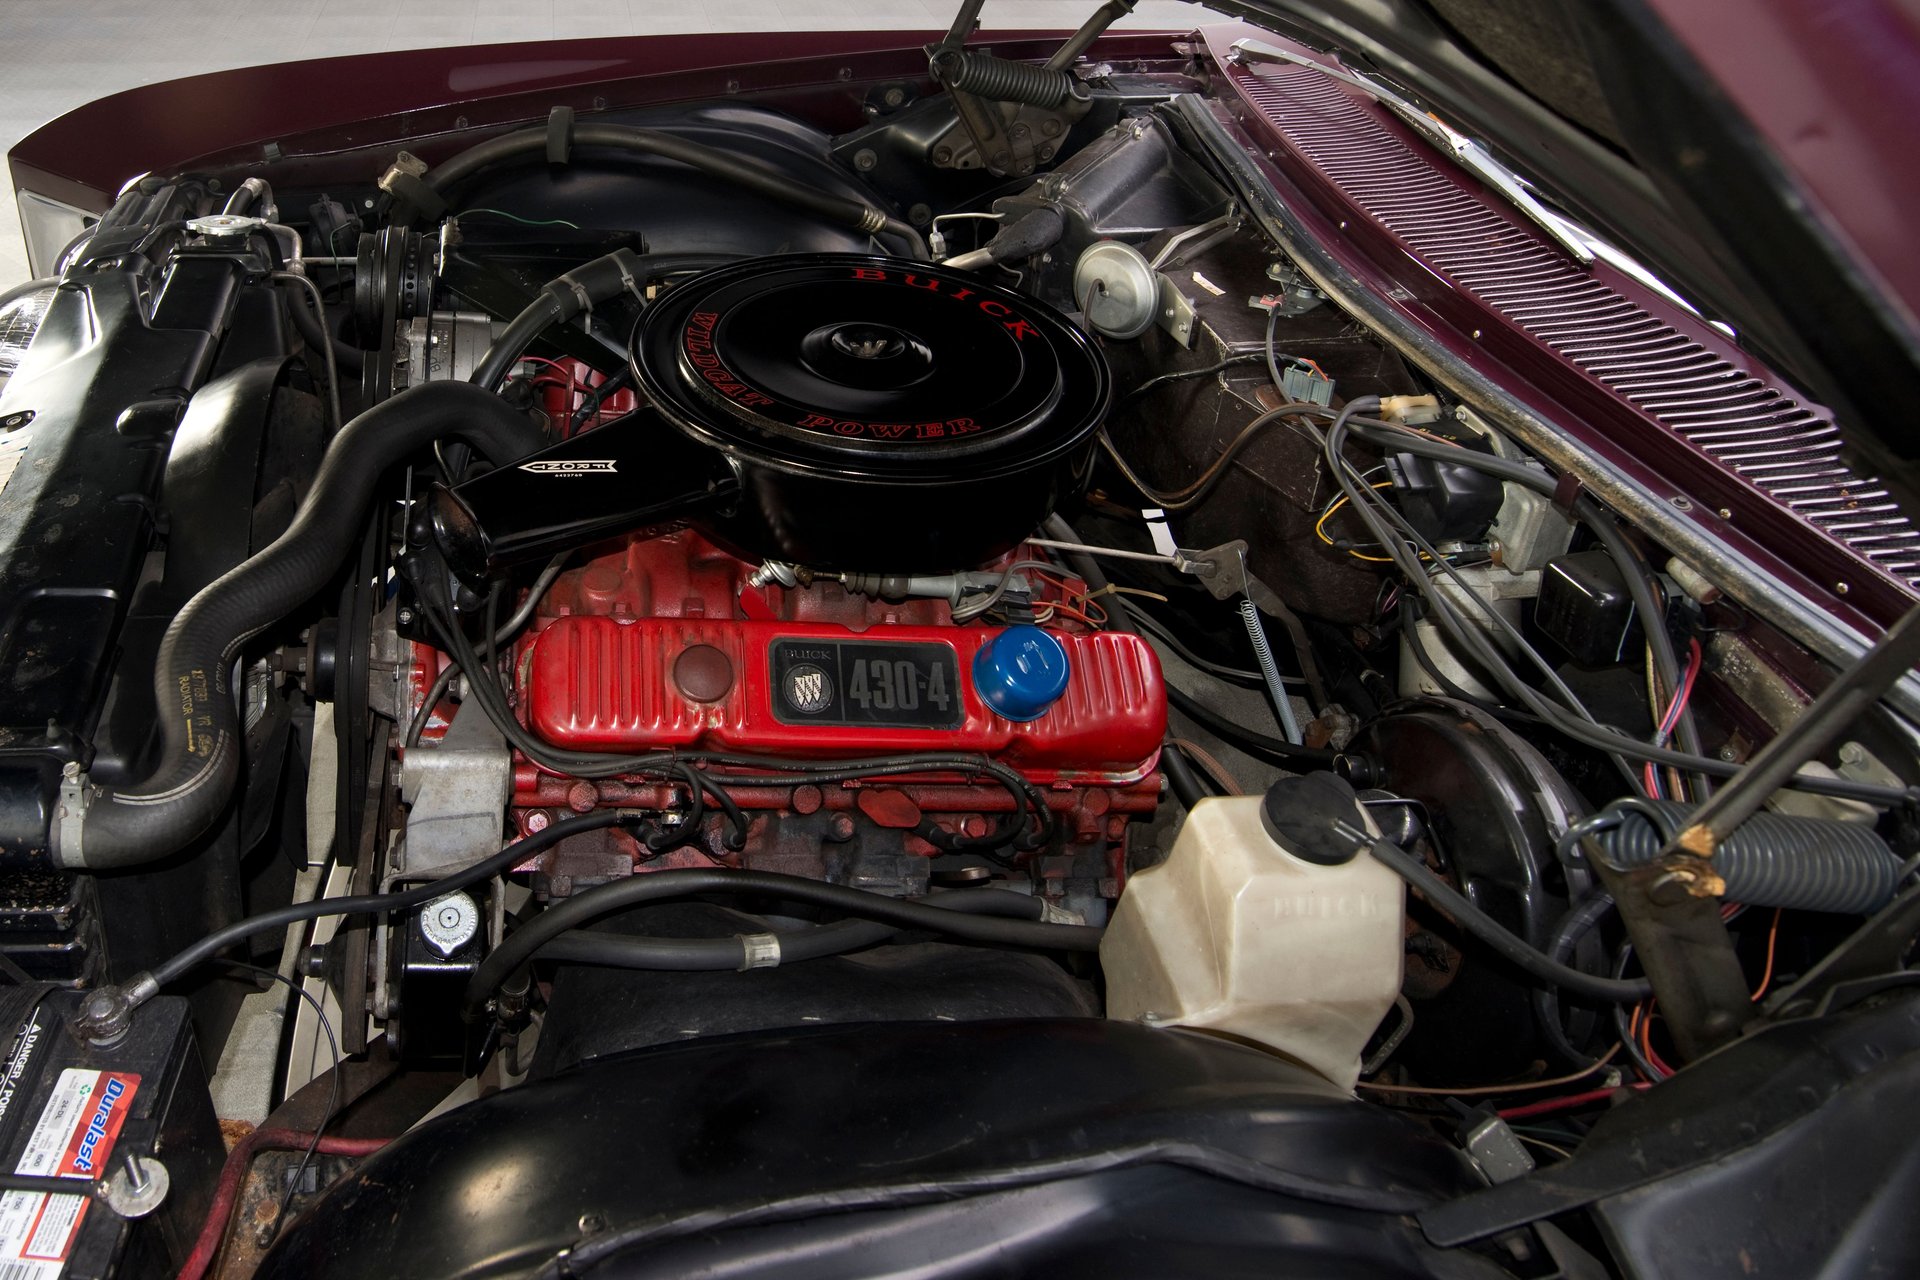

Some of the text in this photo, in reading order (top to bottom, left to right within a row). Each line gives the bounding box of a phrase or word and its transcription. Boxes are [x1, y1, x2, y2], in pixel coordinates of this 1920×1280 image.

[851, 268, 1040, 341] BUICK
[687, 311, 774, 406] WILDCAT
[797, 414, 981, 438] POWER
[784, 649, 832, 660] BUICK
[179, 675, 194, 716] RADIATOR
[850, 659, 950, 711] 430-4
[10, 1034, 38, 1080] DANGER
[33, 1099, 69, 1168] 24-DL 600
[72, 1077, 125, 1172] Duralast
